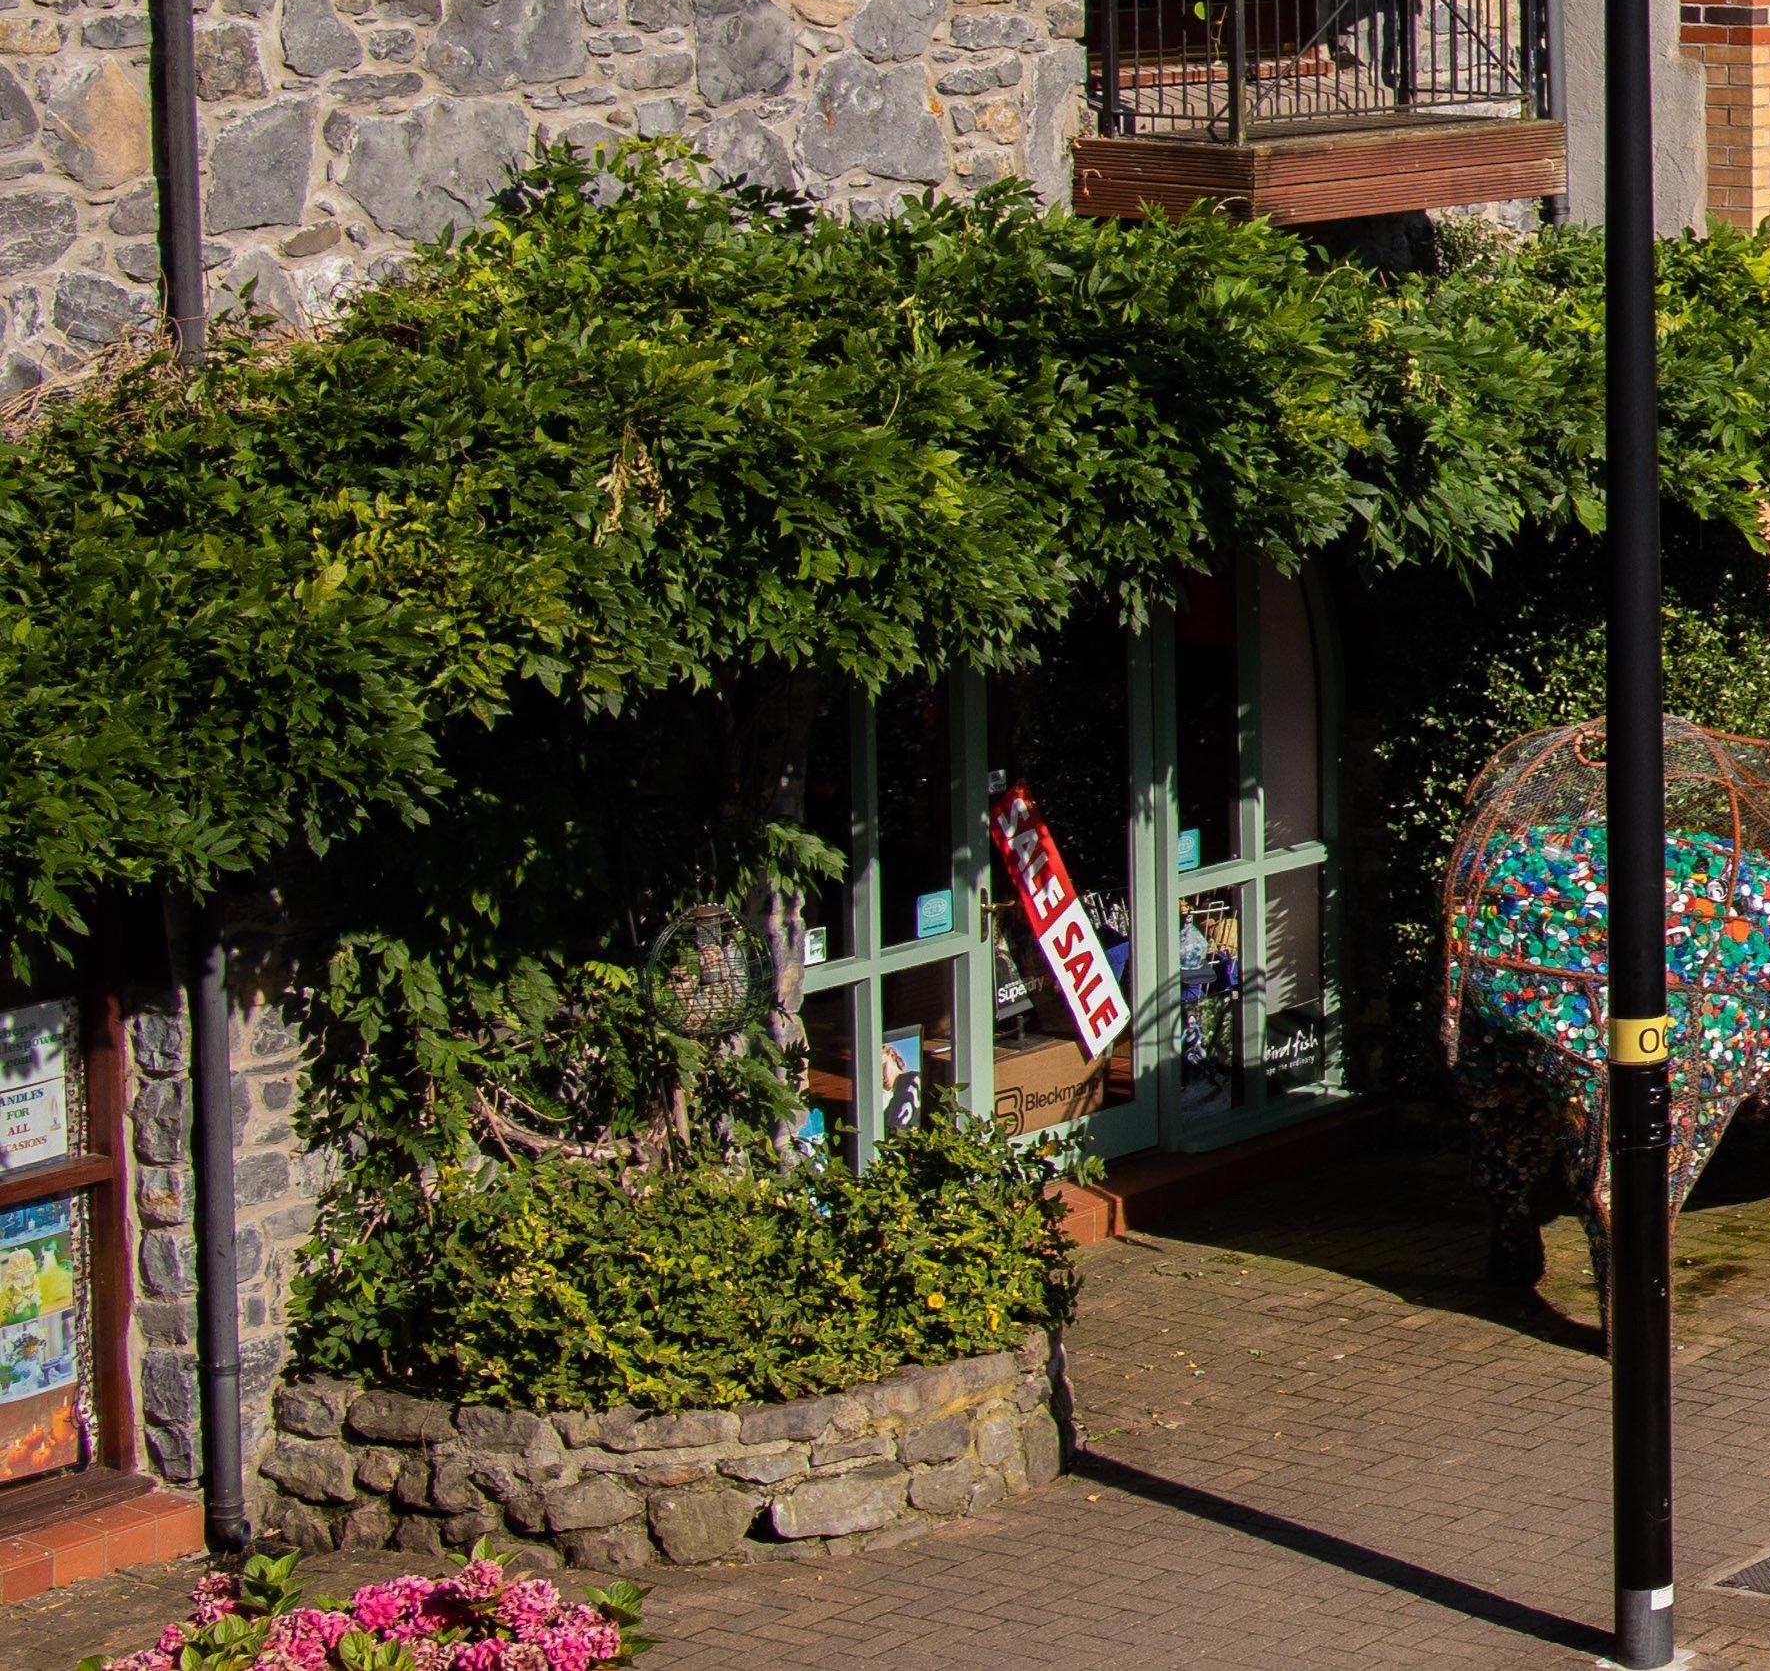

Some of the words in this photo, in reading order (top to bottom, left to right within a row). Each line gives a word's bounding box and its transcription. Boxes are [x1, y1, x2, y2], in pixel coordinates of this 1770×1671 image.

[997, 797, 1066, 920] SALE
[1052, 920, 1119, 1039] SALE
[1292, 1023, 1318, 1057] fish
[6, 1107, 30, 1121] FOR
[7, 1123, 30, 1137] ALL
